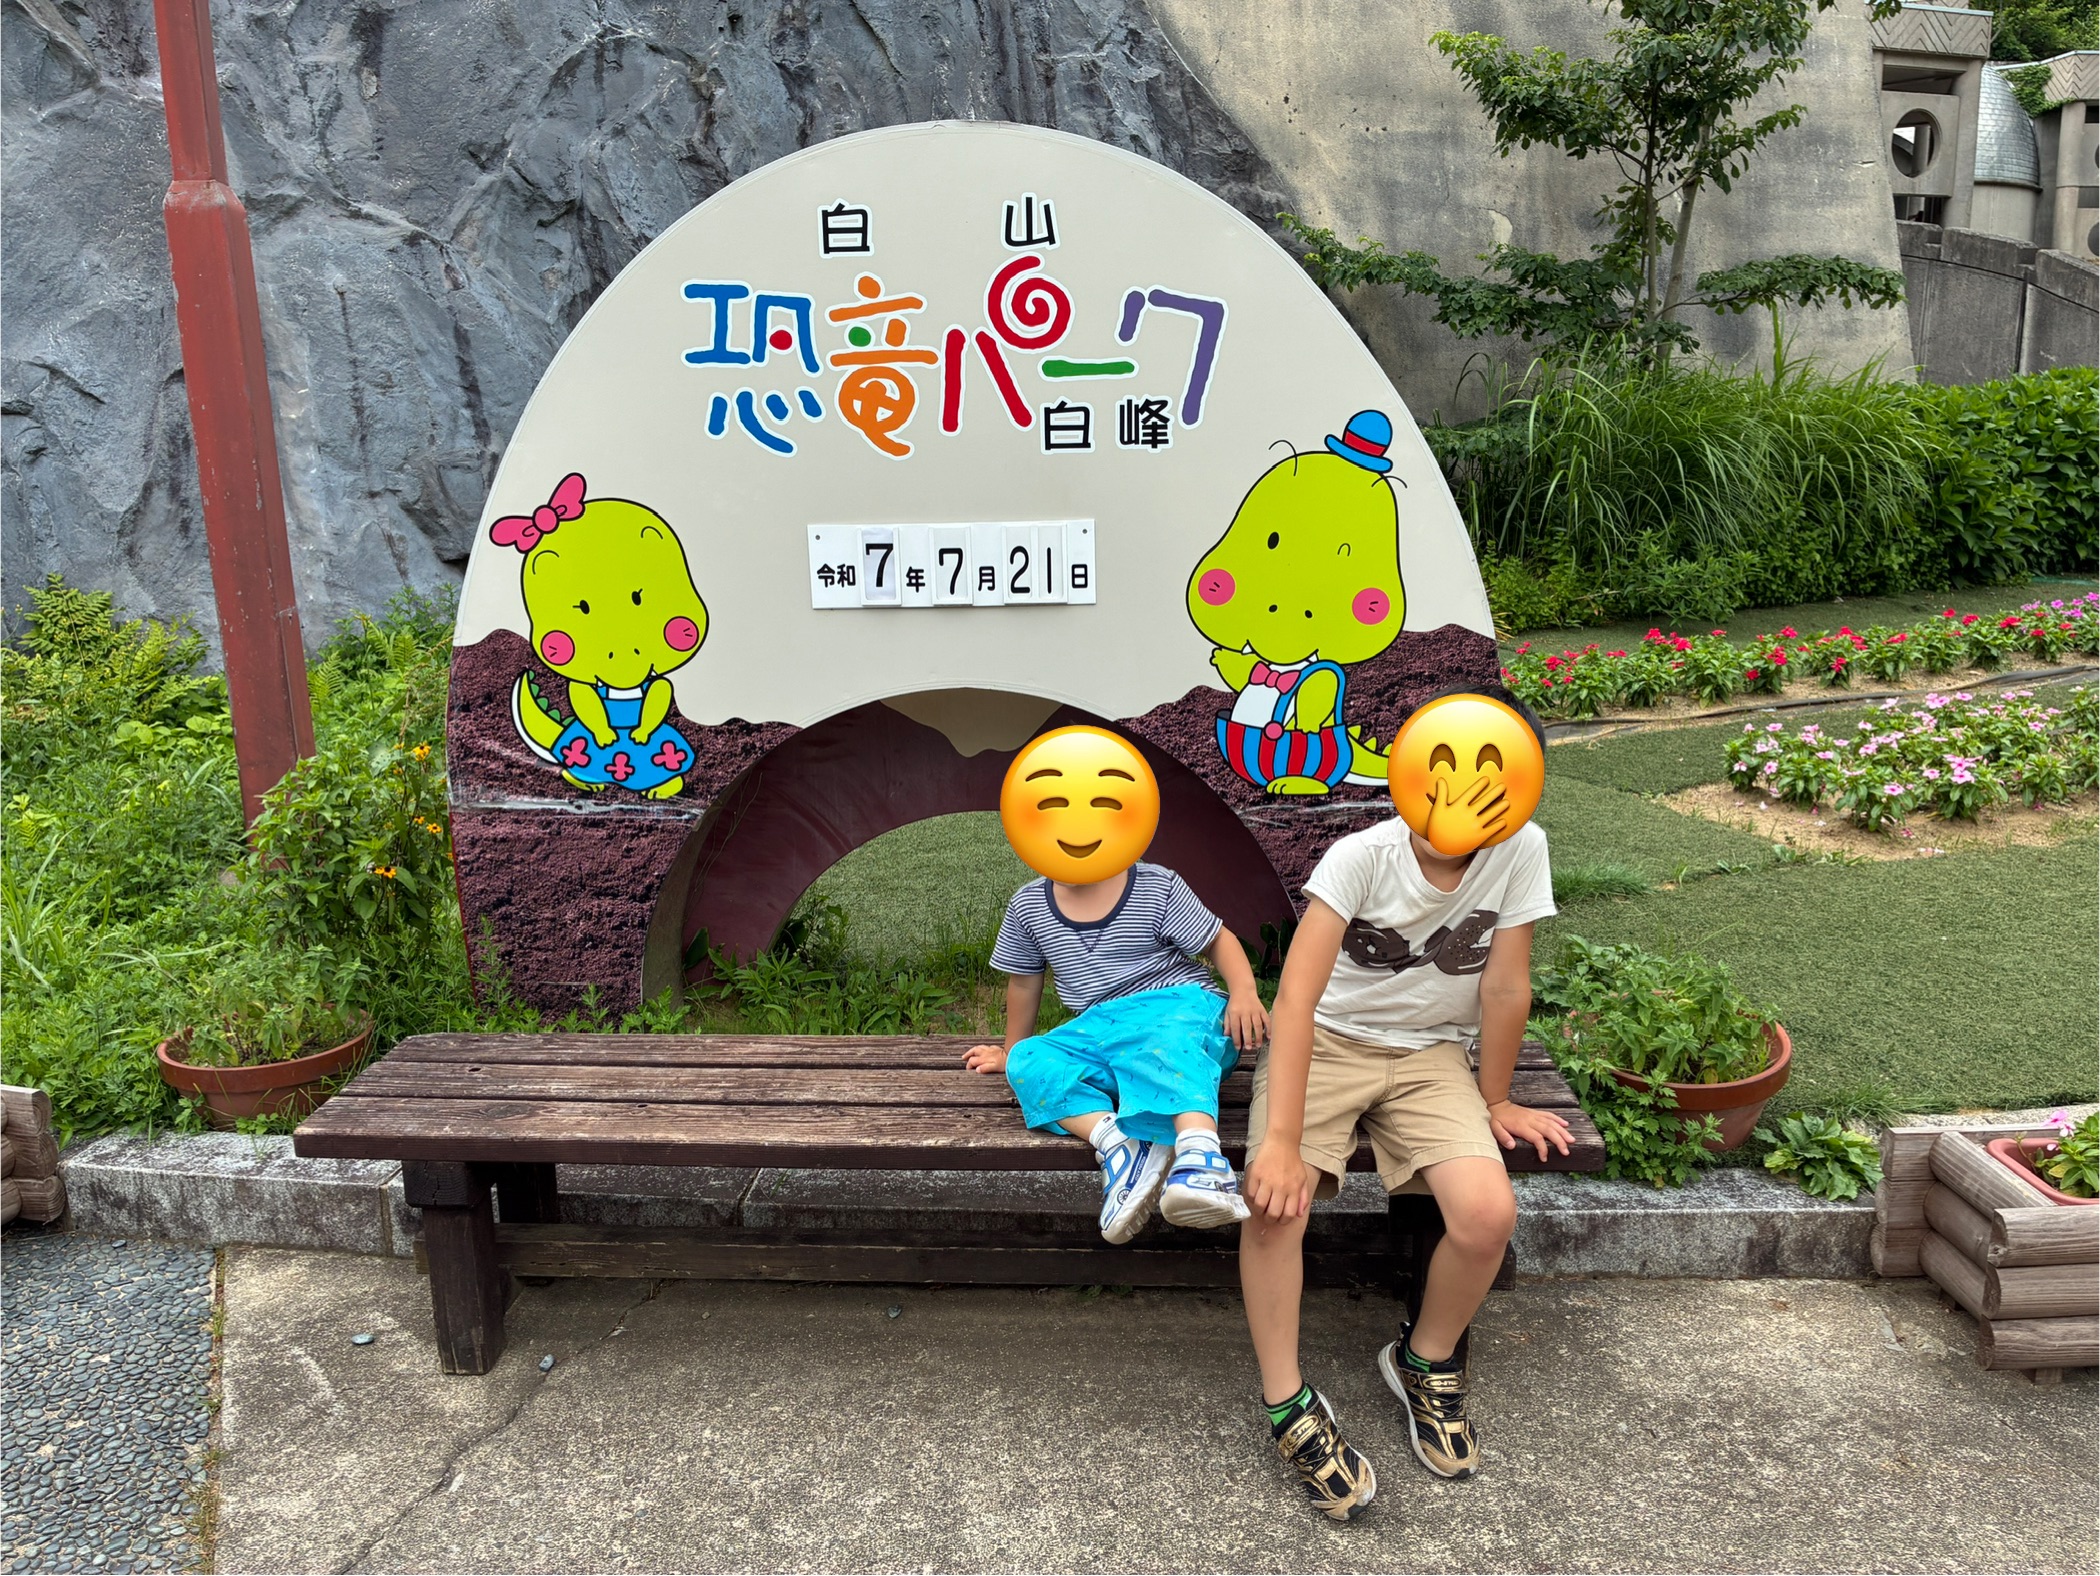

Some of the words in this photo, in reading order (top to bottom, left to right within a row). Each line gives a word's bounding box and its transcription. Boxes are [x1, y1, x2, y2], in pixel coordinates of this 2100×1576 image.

[822, 197, 1056, 254] 白山
[684, 256, 1223, 456] 恐竜パーク
[1045, 400, 1170, 451] 白峰
[817, 543, 1088, 595] 令和7年7月21日
